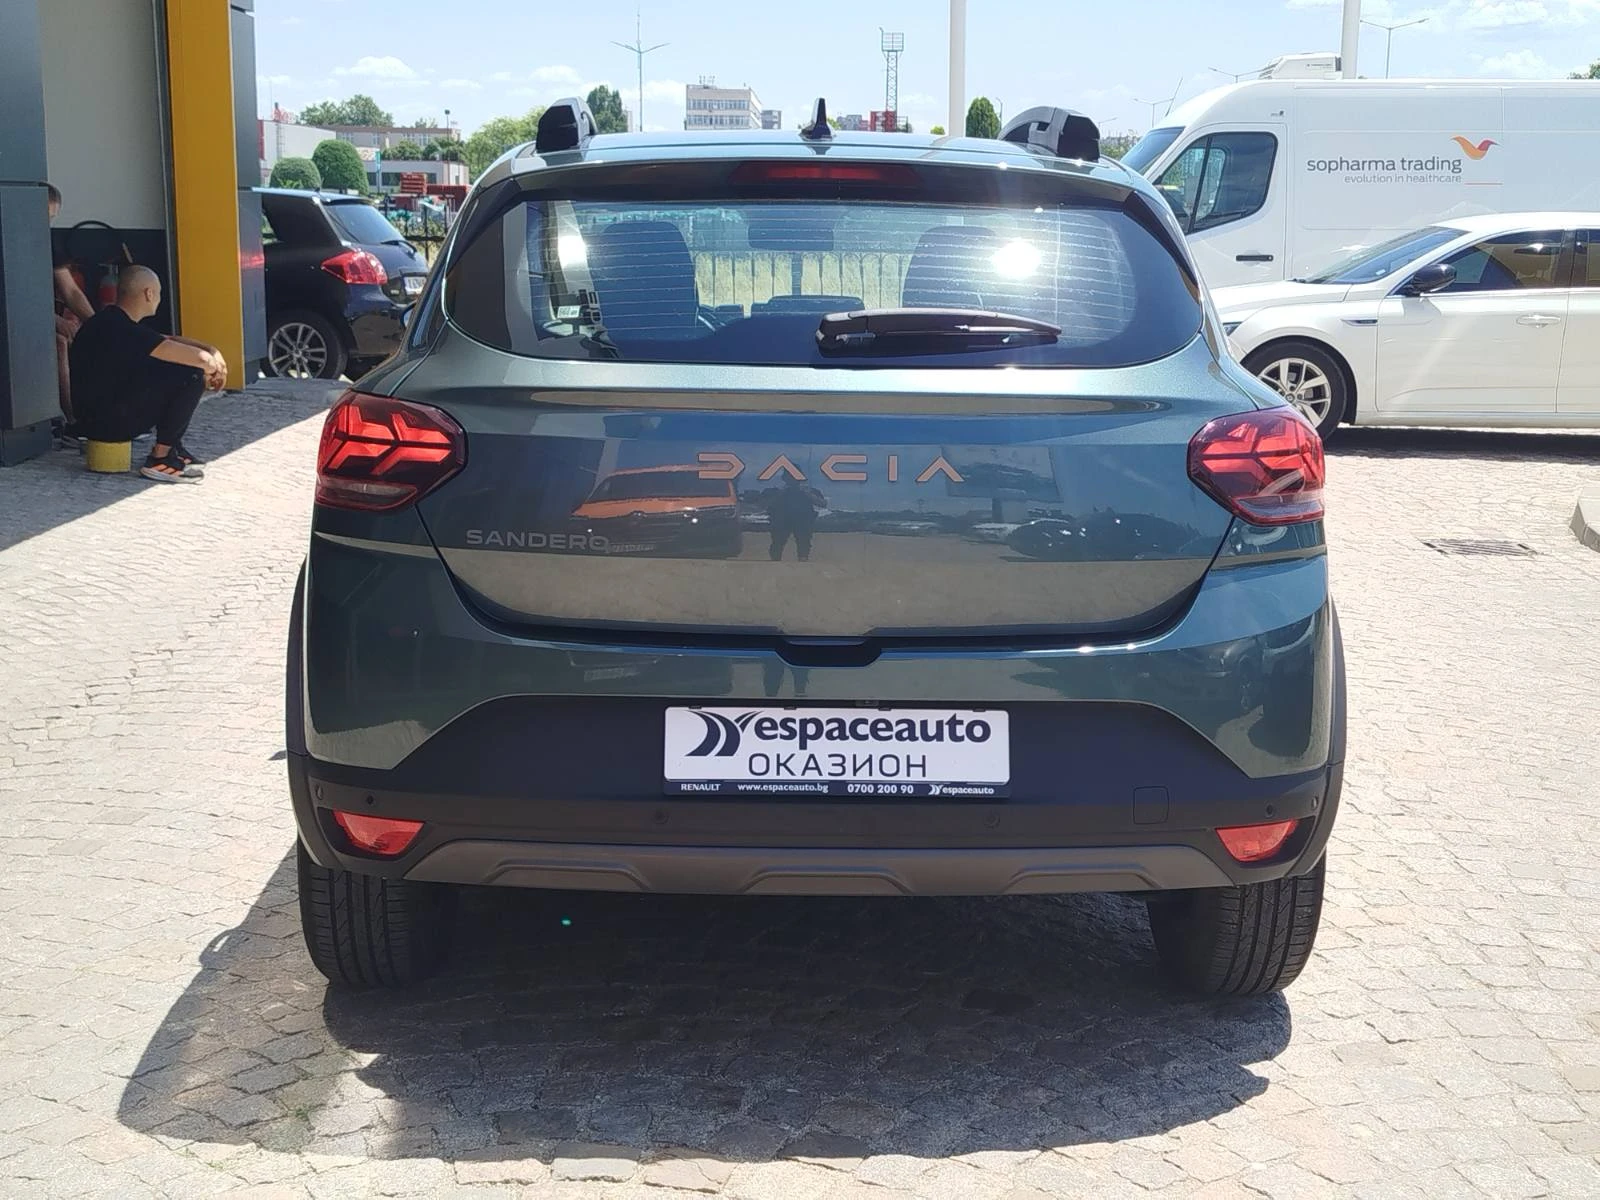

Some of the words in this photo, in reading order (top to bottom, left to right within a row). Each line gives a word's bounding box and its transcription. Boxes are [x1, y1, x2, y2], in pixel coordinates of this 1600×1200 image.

[1307, 157, 1396, 173] sopharma
[1401, 157, 1462, 173] trading
[1345, 174, 1393, 183] evolution
[1395, 174, 1404, 183] in
[1406, 174, 1462, 183] healthcare
[697, 453, 965, 483] DACIA
[466, 530, 609, 552] SANDERO
[754, 713, 992, 750] espaceauto
[748, 753, 927, 778] ОКАЗИОН
[680, 783, 721, 791] RENAULT
[737, 783, 829, 793] www.espaceauto.bg
[847, 783, 873, 793] 0700
[877, 784, 898, 794] 200
[900, 784, 914, 794] 90
[942, 786, 995, 795] espaceauto
